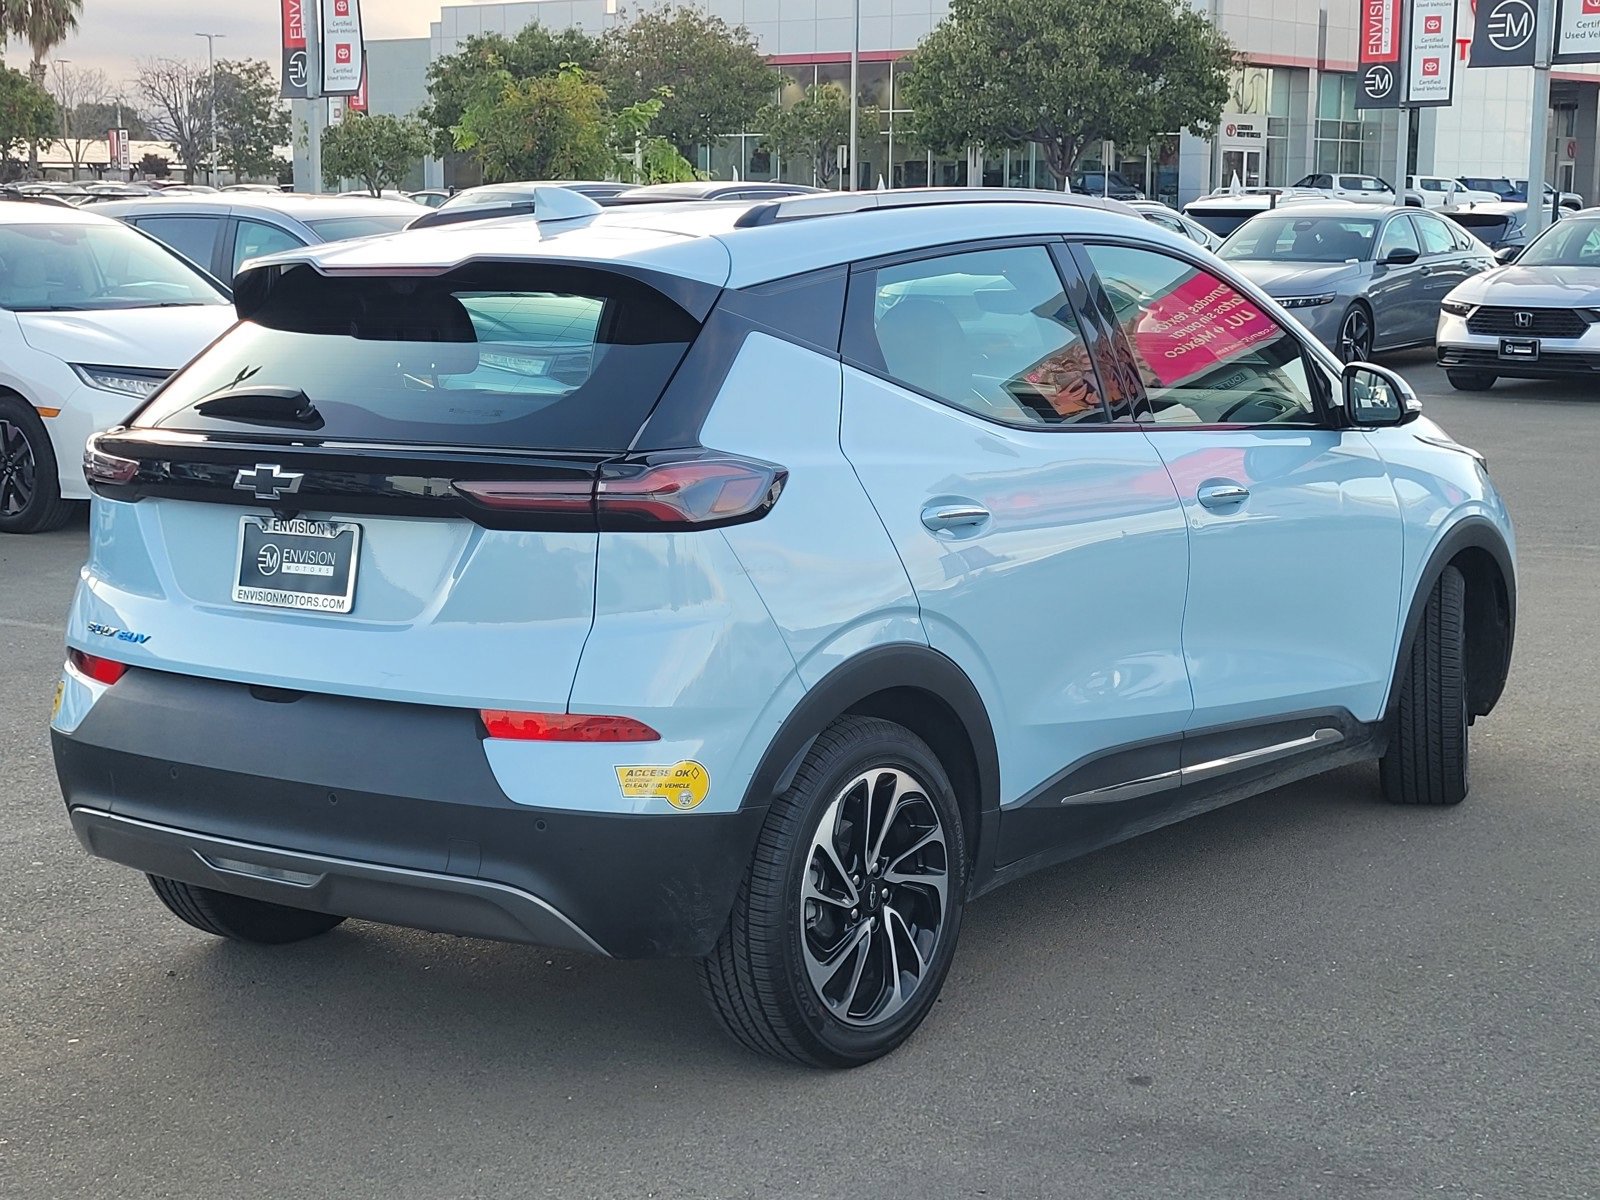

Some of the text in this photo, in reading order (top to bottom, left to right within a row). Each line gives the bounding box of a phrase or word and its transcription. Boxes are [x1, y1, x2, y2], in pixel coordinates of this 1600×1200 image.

[1565, 31, 1586, 39] Used
[273, 520, 325, 536] ENVISION
[283, 548, 336, 565] ENVISION
[286, 566, 330, 574] MOTORS
[237, 589, 345, 610] ENVISIONMOTORS.COM
[626, 769, 691, 777] ACCESS OK
